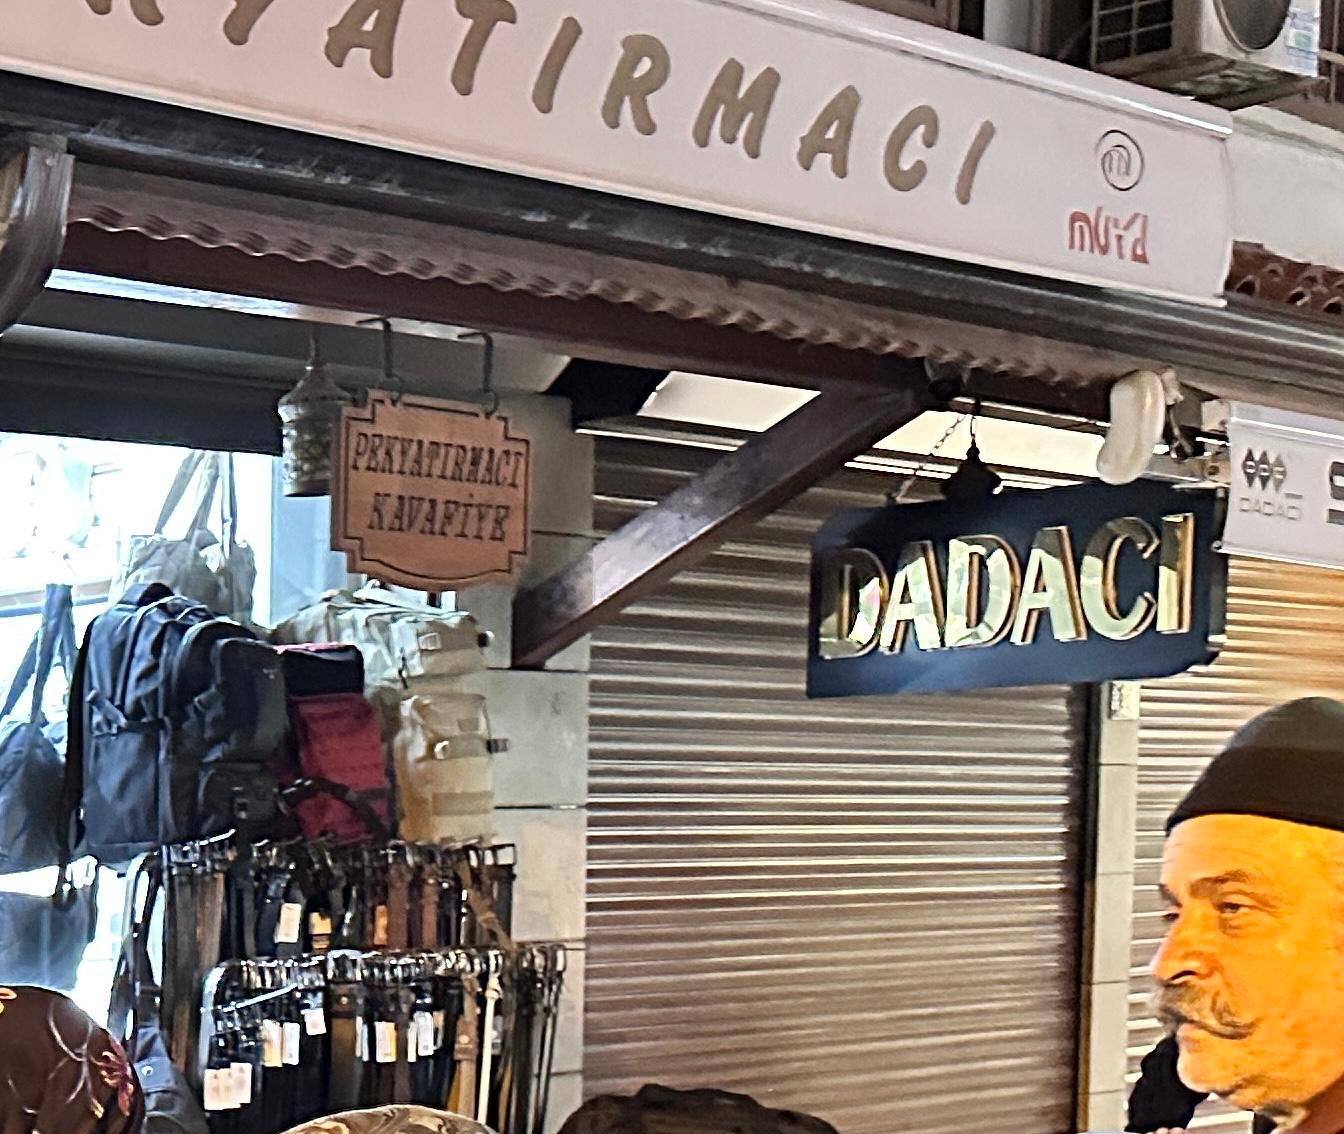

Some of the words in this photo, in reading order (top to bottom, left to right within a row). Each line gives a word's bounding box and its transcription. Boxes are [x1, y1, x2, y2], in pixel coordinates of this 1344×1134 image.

[352, 432, 524, 488] PEKYATIRMACI
[368, 492, 511, 542] KAVAFİYE
[819, 512, 1195, 660] DADACI
